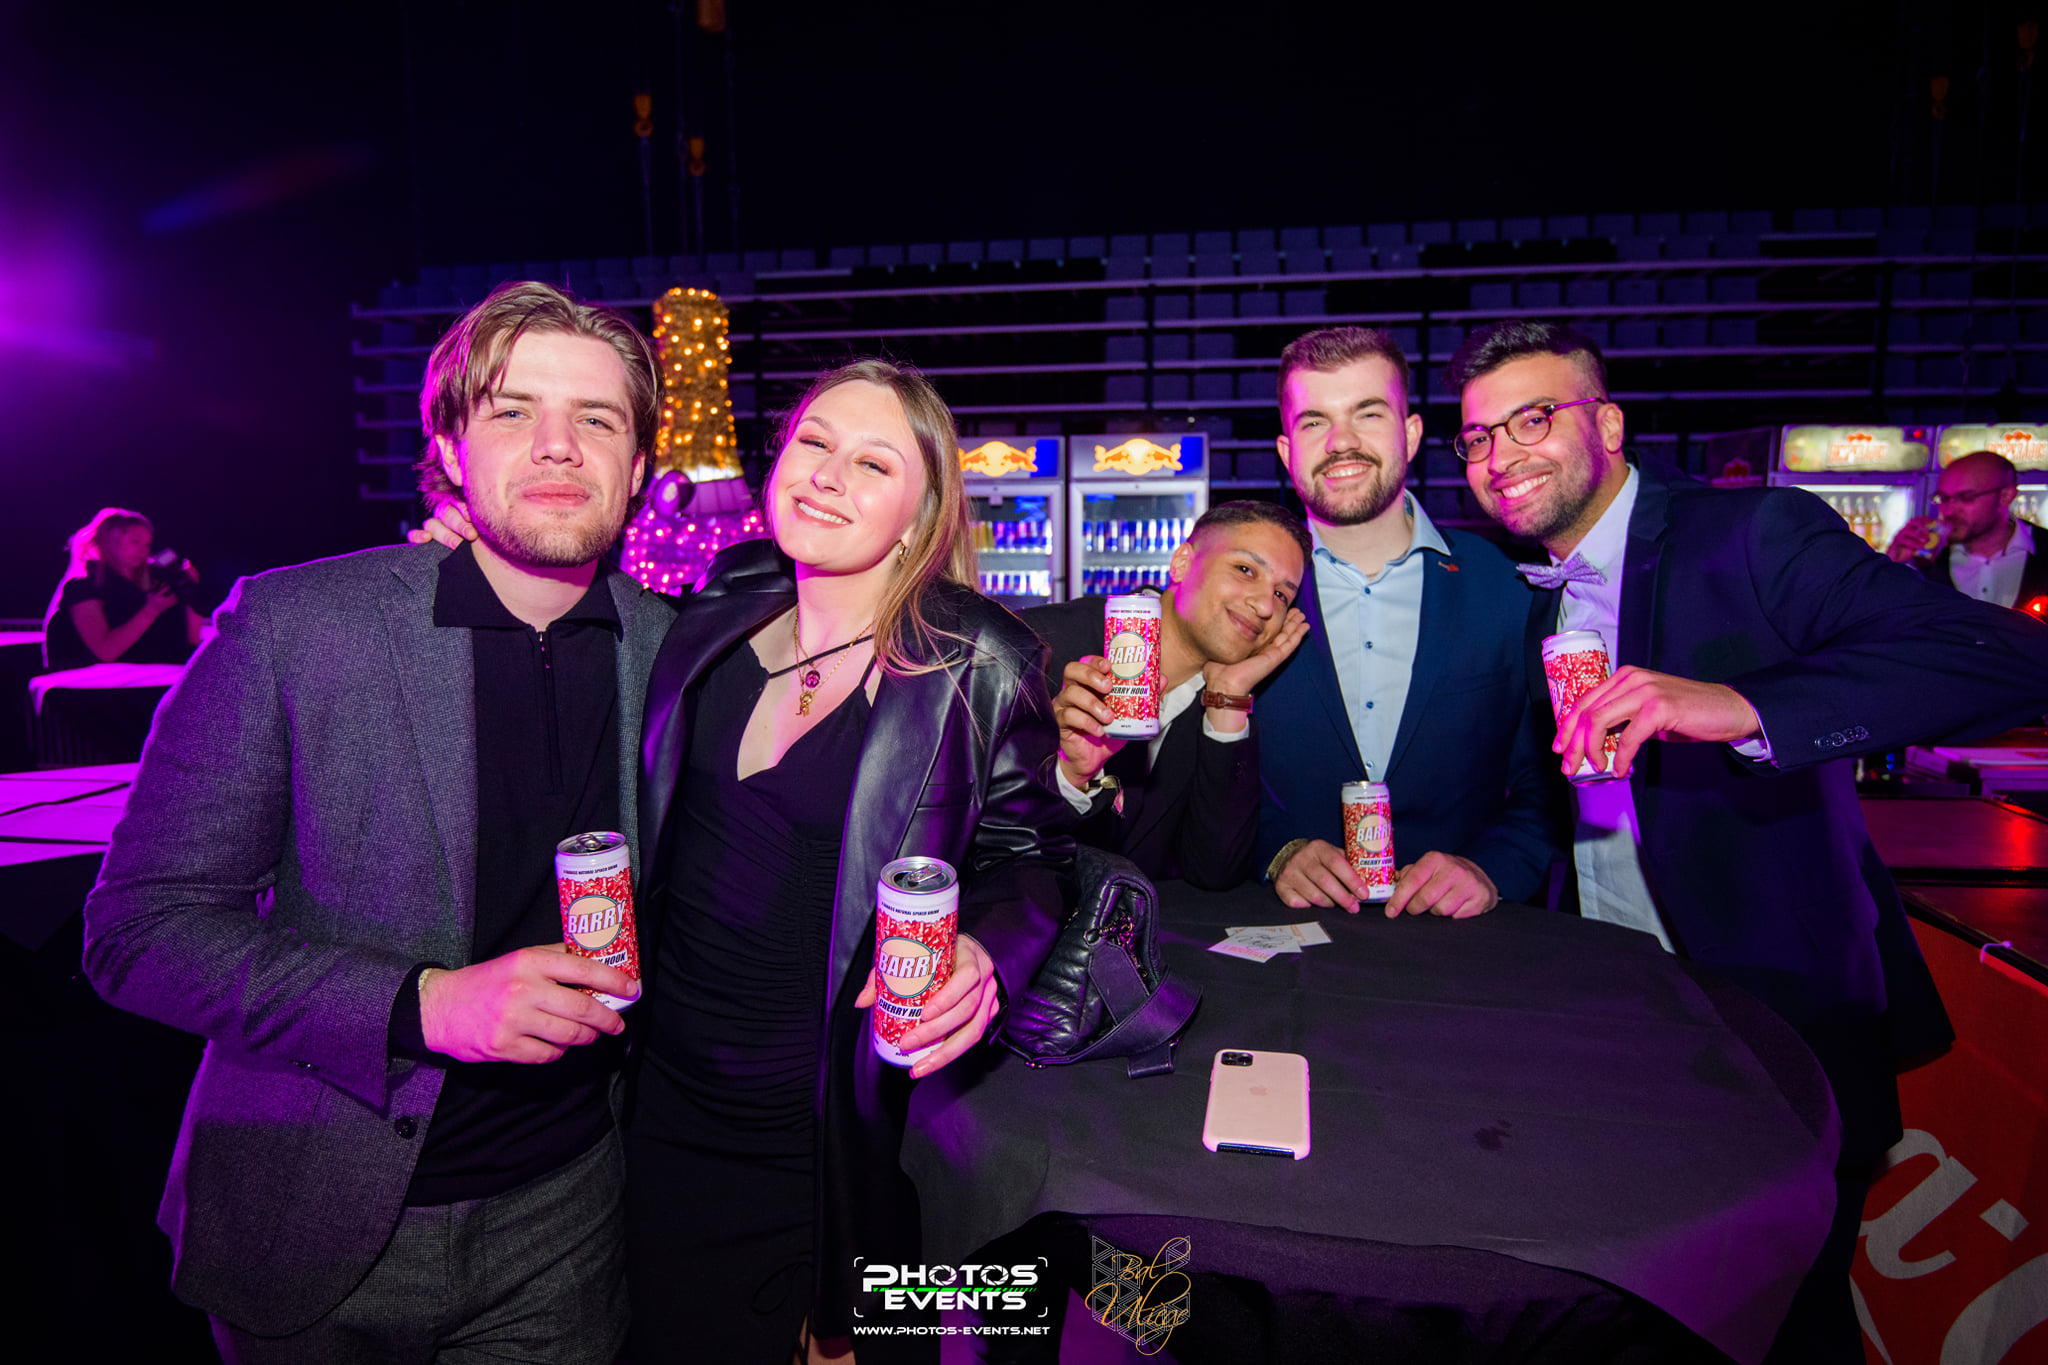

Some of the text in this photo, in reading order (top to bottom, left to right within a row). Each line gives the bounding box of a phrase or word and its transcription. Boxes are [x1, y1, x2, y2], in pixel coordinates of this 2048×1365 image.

[1108, 643, 1154, 664] BARRY
[1111, 686, 1130, 695] HERRY
[567, 901, 626, 934] BARRY
[604, 951, 626, 966] HOOK
[878, 947, 945, 979] BARRY
[878, 998, 922, 1019] CHERRY HO
